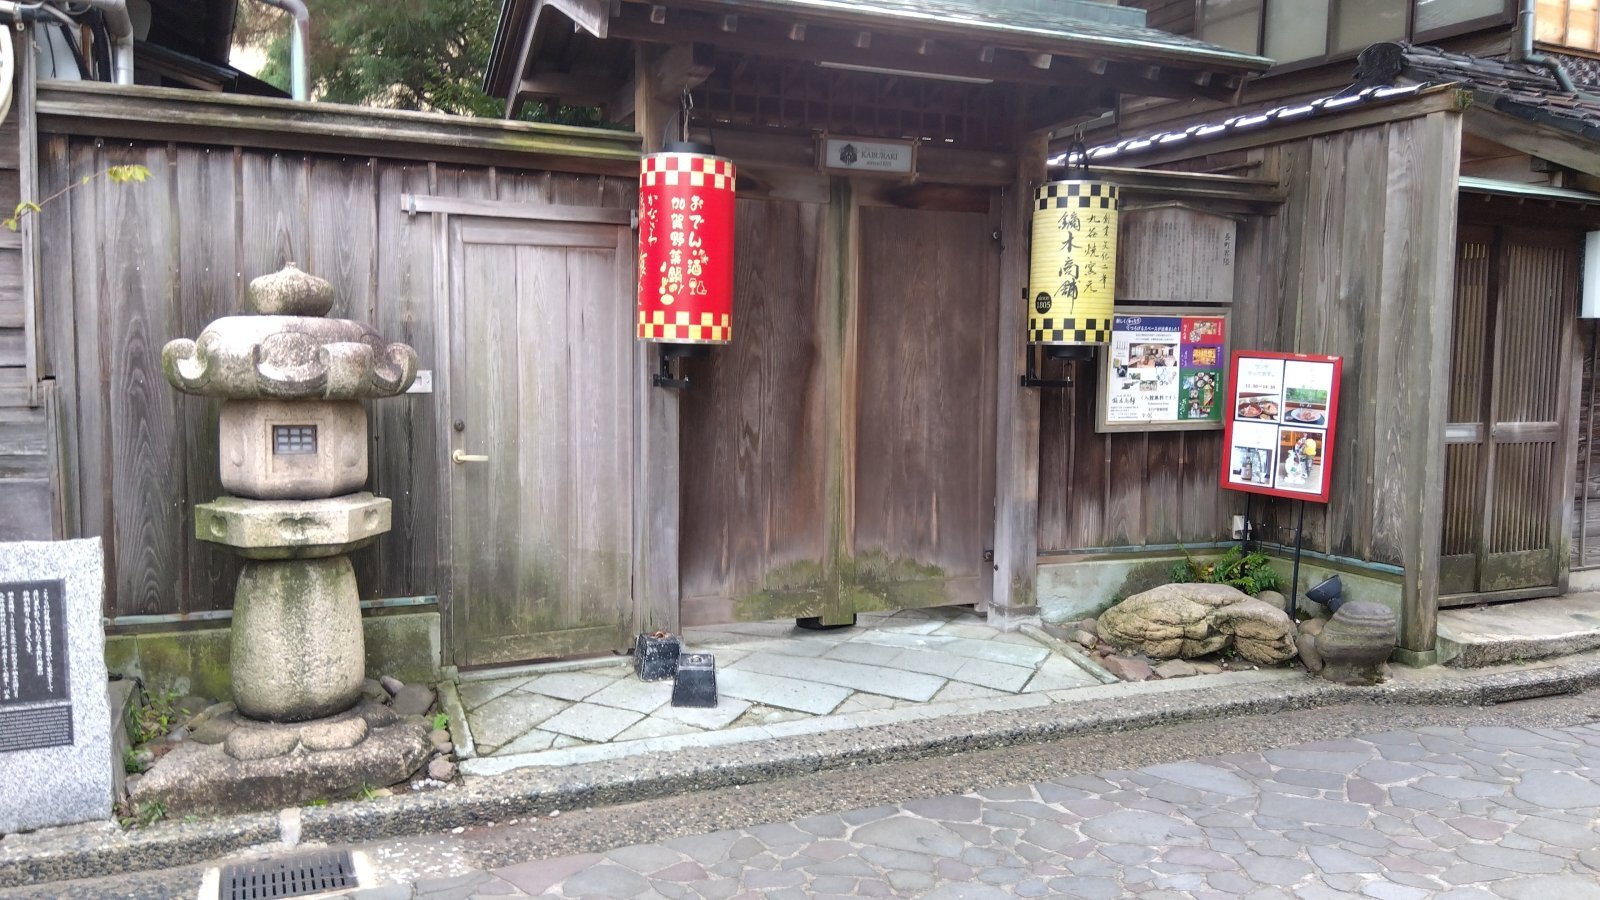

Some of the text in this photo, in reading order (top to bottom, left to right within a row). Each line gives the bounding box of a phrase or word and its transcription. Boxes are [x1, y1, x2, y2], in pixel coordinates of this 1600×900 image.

[1083, 214, 1101, 293] 九谷焼窯元
[1036, 301, 1051, 309] 1805
